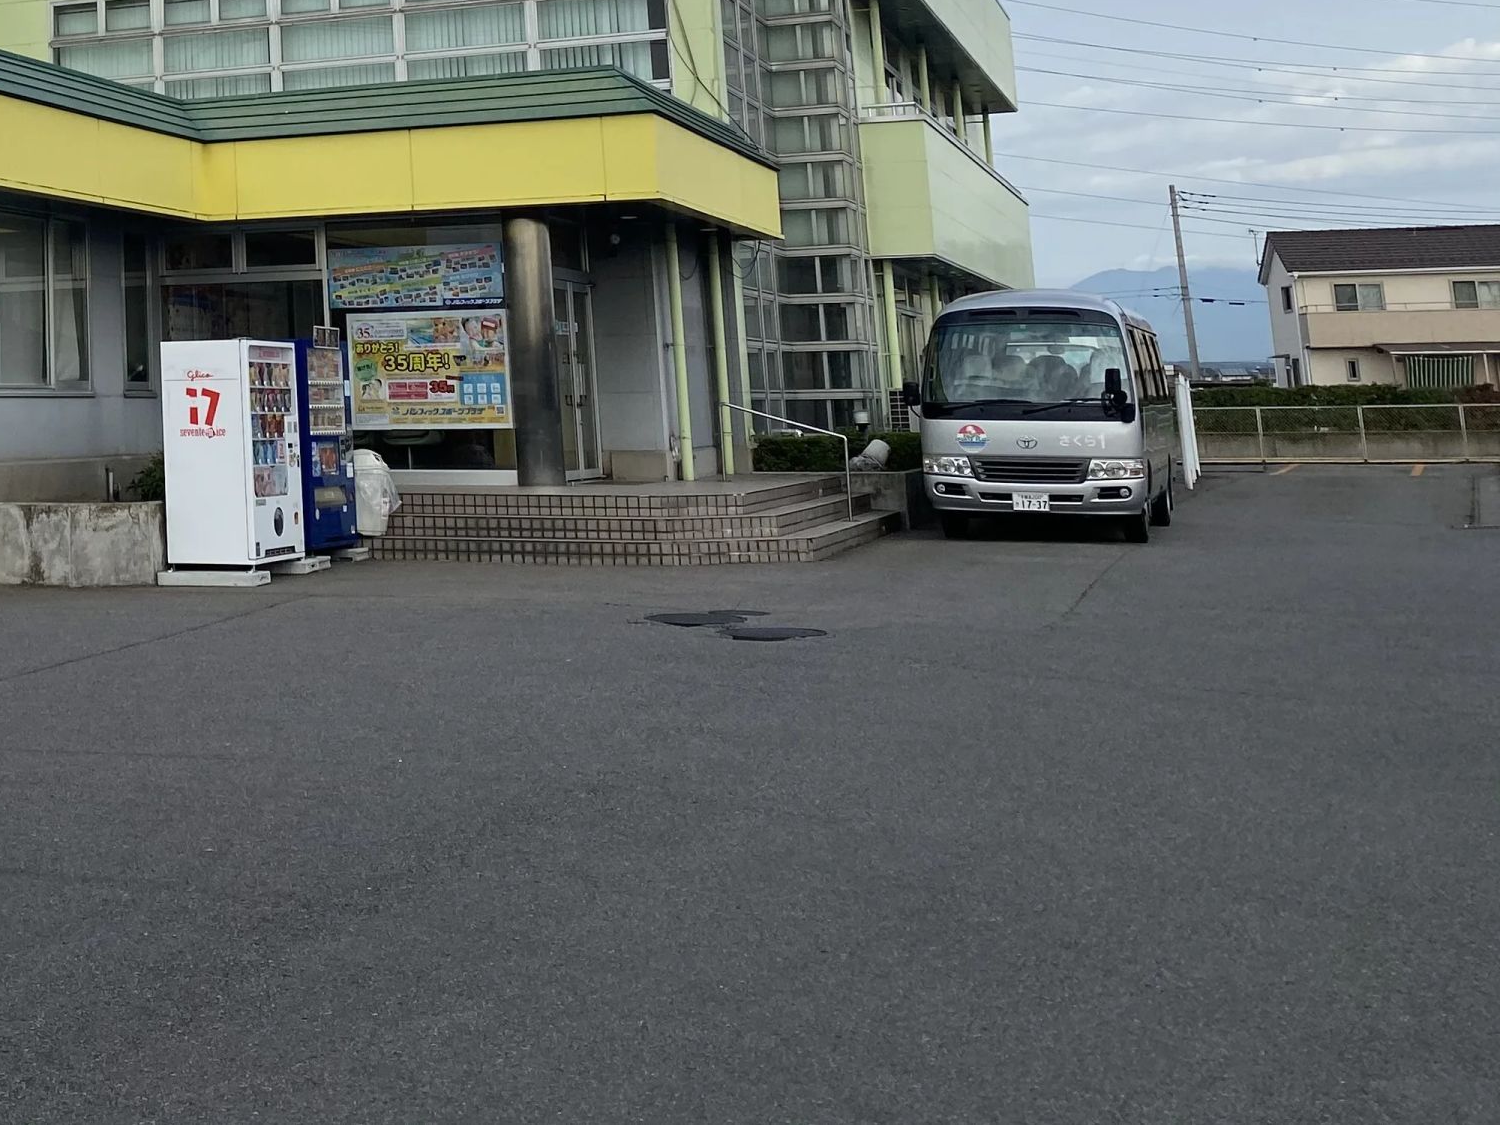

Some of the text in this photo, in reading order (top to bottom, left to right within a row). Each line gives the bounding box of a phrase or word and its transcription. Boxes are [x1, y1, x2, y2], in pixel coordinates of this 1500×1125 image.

[355, 342, 400, 354] ありがとう!
[384, 352, 451, 372] 35周年!
[1059, 433, 1105, 449] さくら1
